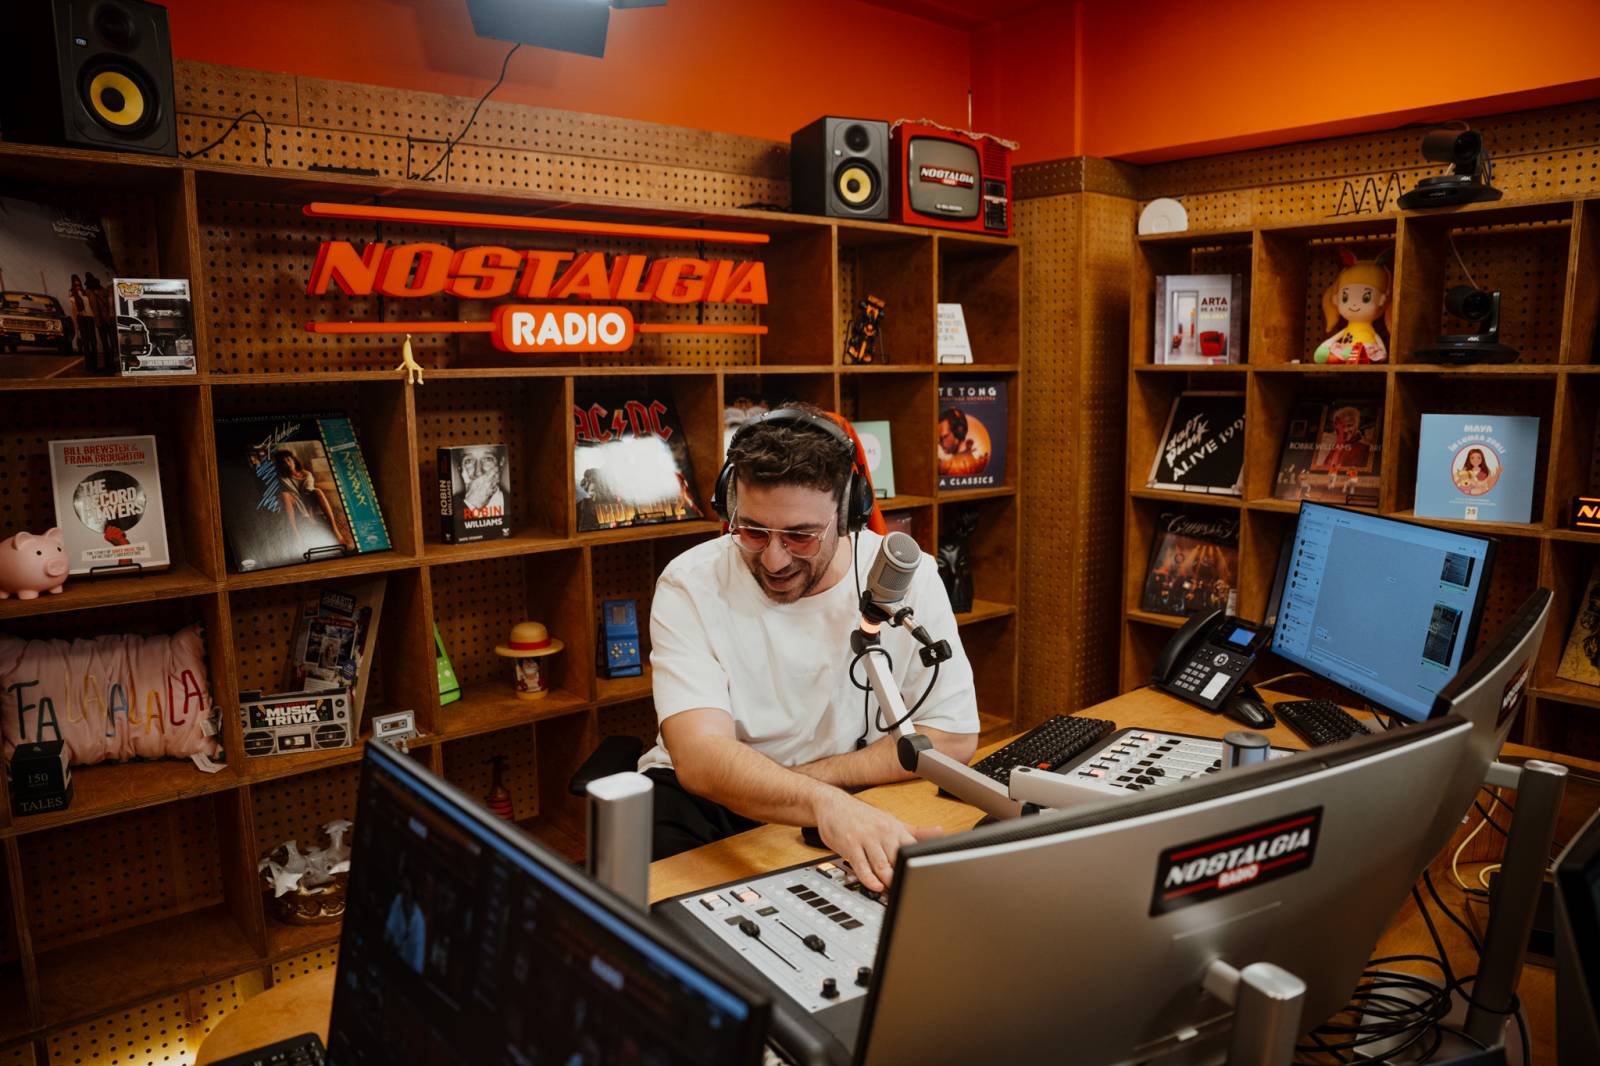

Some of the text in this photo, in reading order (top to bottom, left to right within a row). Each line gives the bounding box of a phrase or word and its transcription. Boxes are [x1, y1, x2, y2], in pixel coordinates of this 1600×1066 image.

[920, 167, 974, 184] NOSTALGIA
[307, 241, 769, 305] NOSTALGIA
[1201, 297, 1228, 305] ARTA
[511, 311, 626, 346] RADIO
[959, 387, 997, 396] TONG
[1218, 414, 1246, 443] 199
[64, 454, 93, 465] FRANK
[1173, 438, 1219, 482] ALIVE
[80, 478, 108, 497] THE
[949, 476, 994, 486] CLASSICS
[439, 480, 448, 516] ROBIN
[88, 500, 145, 523] AYERS
[463, 505, 503, 519] ROBIN
[464, 518, 503, 529] WILLIAMS
[167, 669, 205, 726] LA
[264, 712, 320, 727] TRIVIA
[265, 704, 318, 719] MUSIC
[19, 796, 64, 812] TALES
[1165, 828, 1311, 888] NOSTALGIA
